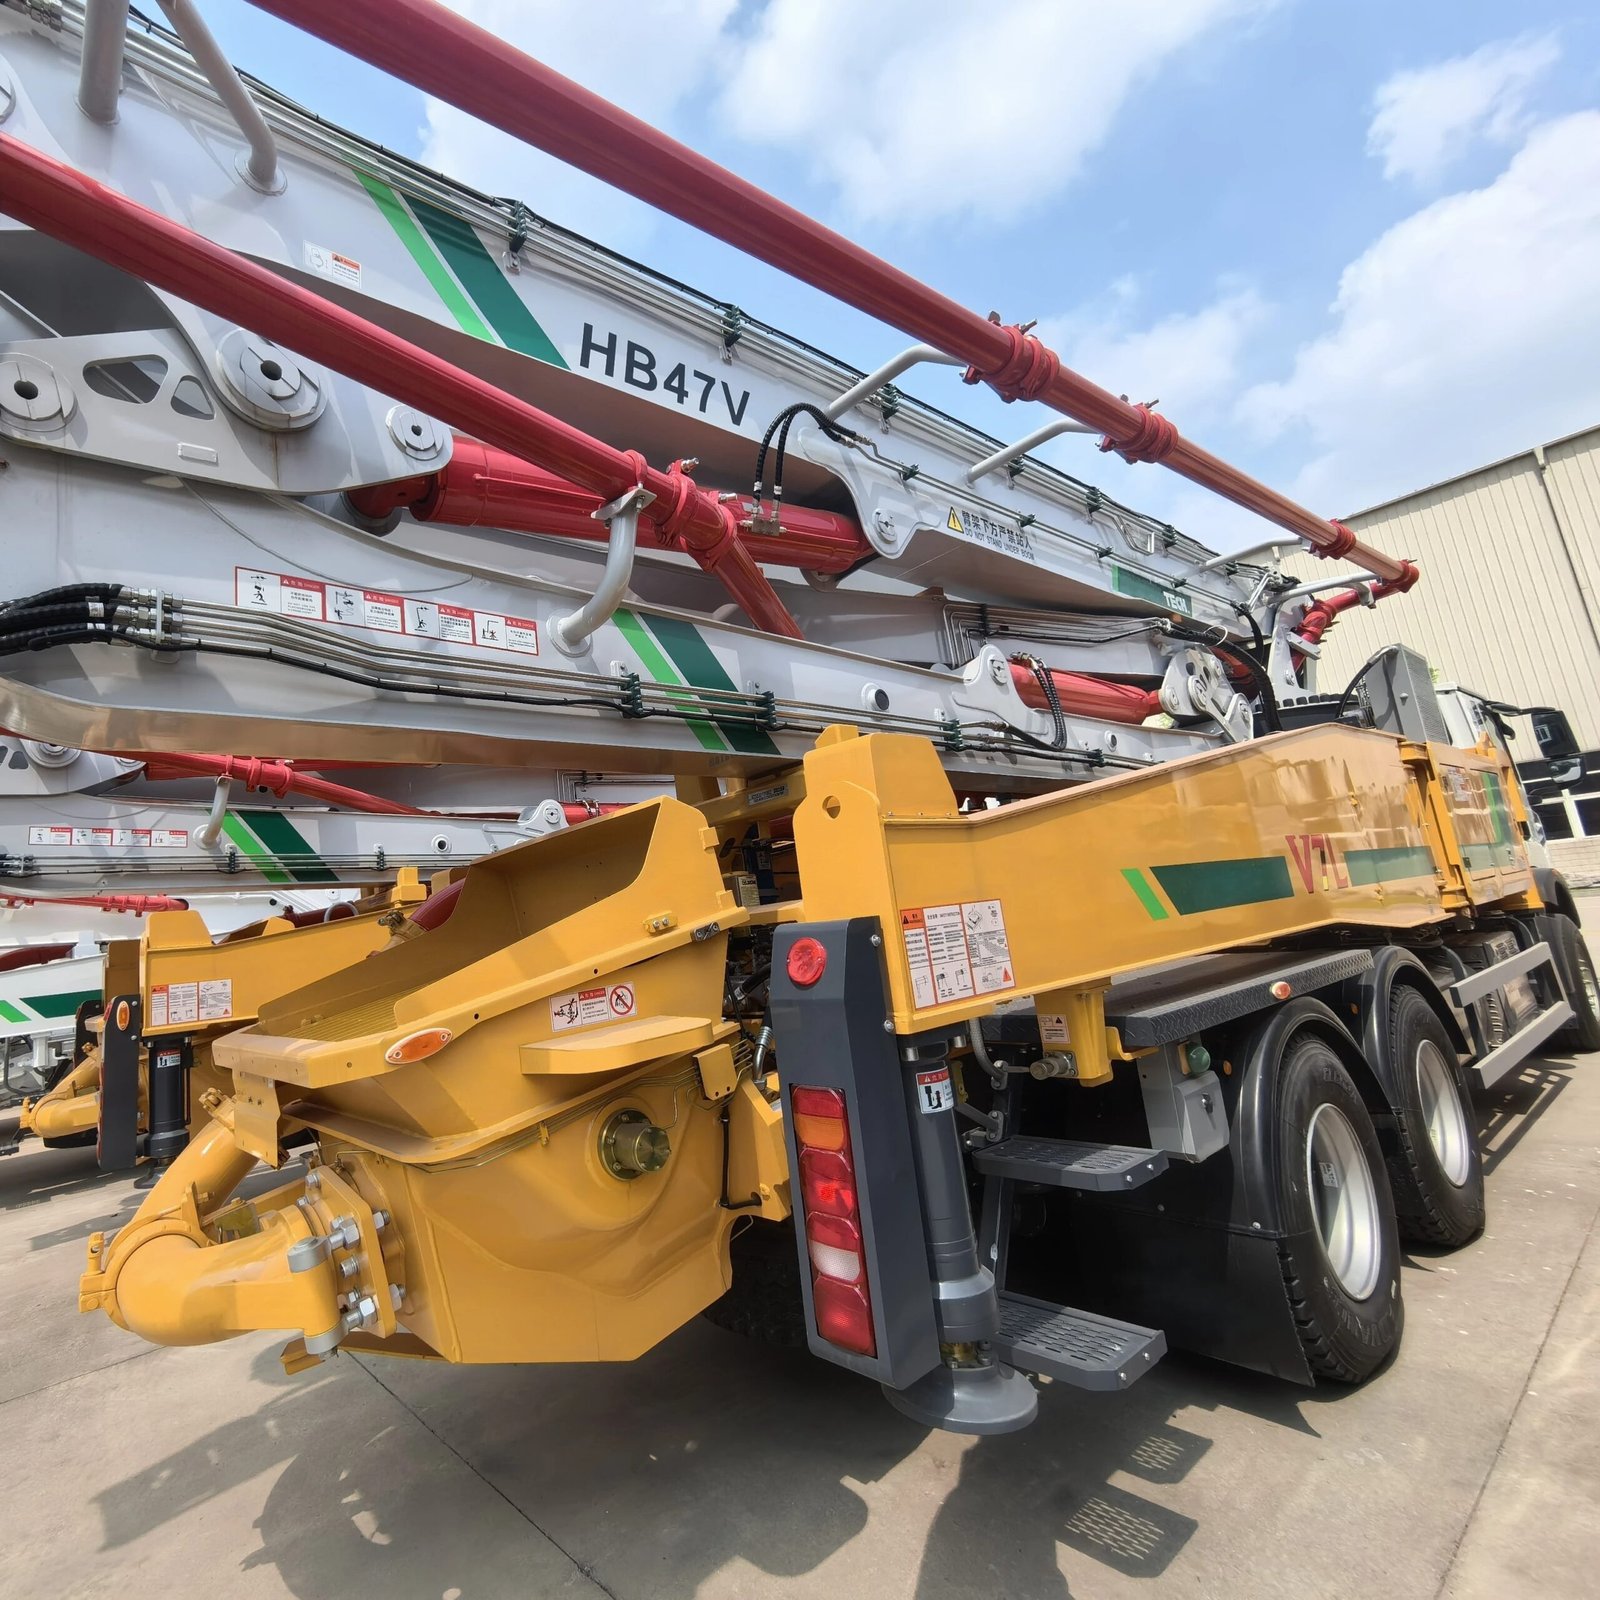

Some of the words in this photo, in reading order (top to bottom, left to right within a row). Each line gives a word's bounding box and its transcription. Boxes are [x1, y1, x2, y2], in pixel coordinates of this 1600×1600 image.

[579, 322, 750, 427] HB47V
[962, 510, 1033, 550] 臂架下方严禁站人
[965, 527, 973, 537] DO
[974, 531, 985, 542] NOT
[987, 535, 1003, 549] STAND
